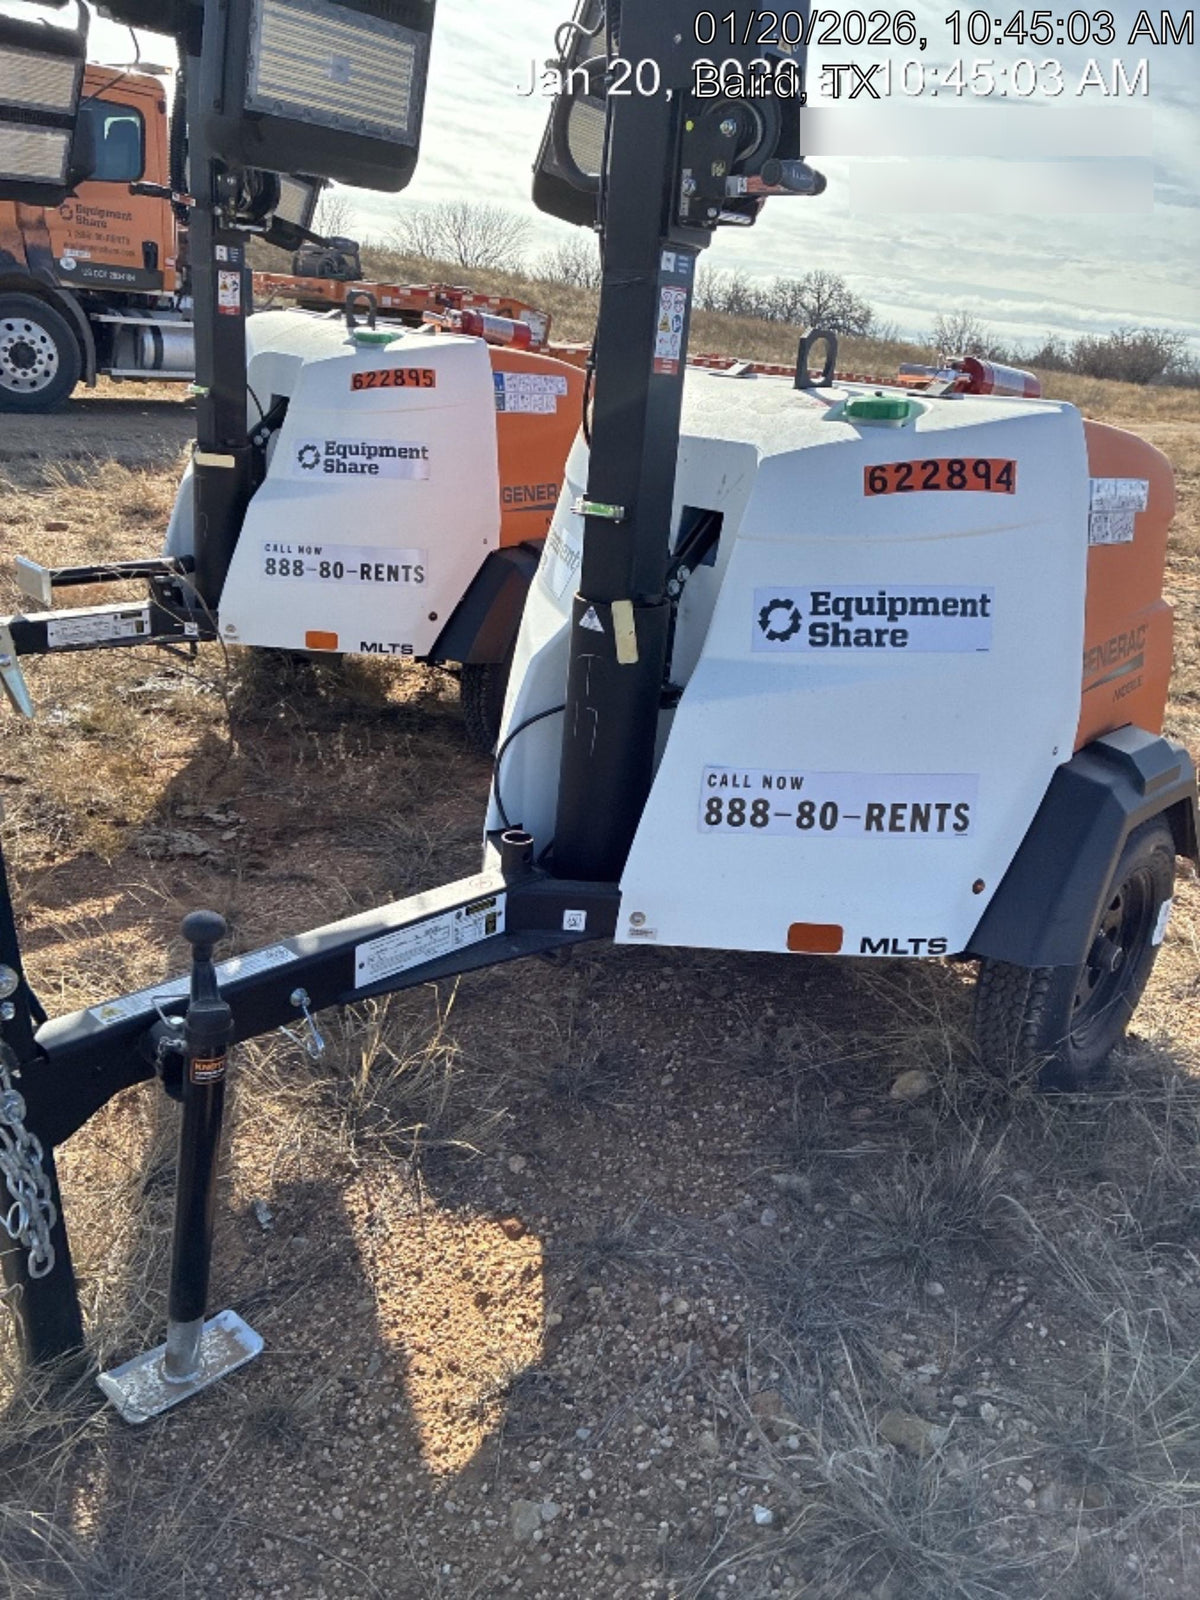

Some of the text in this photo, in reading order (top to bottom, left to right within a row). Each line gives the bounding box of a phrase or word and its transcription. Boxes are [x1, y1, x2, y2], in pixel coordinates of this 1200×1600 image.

[76, 204, 132, 221] Equipment
[76, 215, 107, 228] Share
[352, 369, 434, 389] 622895
[324, 441, 428, 460] Equipment
[324, 459, 379, 475] Share
[867, 458, 1015, 494] 622894
[502, 483, 560, 503] GENER
[264, 544, 322, 555] CALL NOW
[264, 559, 425, 583] 888-80-RENTS
[809, 590, 991, 622] Equipment
[808, 622, 908, 648] Share
[360, 641, 413, 655] MLTS
[707, 774, 804, 790] CALL NOW
[704, 797, 970, 832] 888-80-RENTS
[860, 937, 948, 955] MLTS
